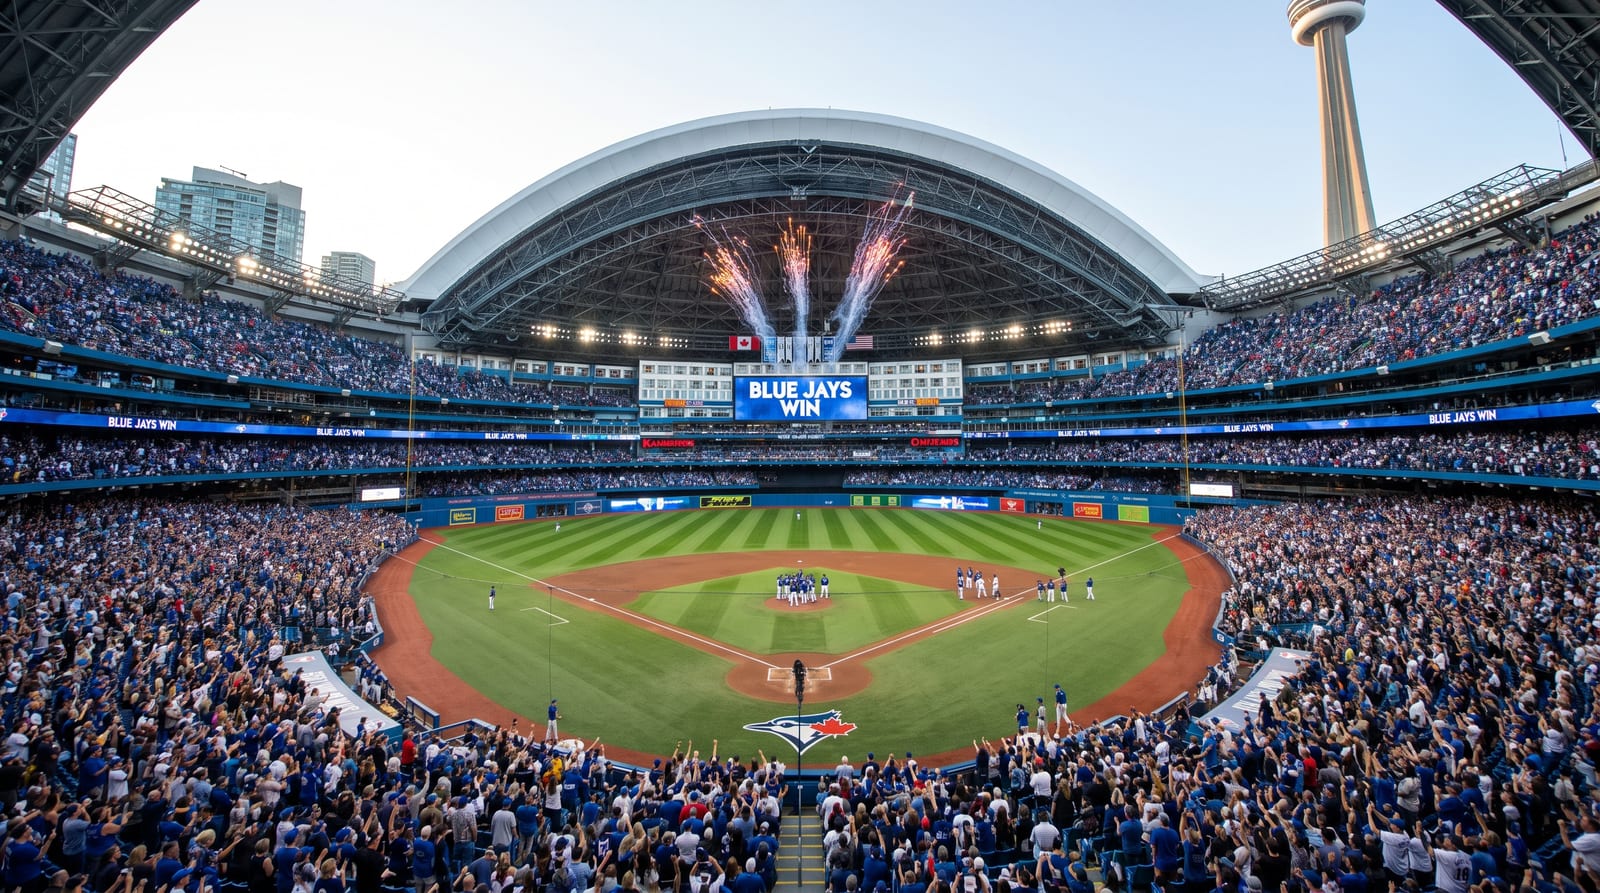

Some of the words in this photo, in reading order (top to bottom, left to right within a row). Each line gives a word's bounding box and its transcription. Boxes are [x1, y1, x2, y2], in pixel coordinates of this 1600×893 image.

[749, 381, 798, 399] BLUE
[803, 381, 853, 399] JAYS
[780, 399, 821, 417] WIN
[108, 416, 132, 428] BLUE
[134, 418, 157, 429] JAYS
[159, 420, 177, 431] WIN
[1429, 413, 1451, 424] BLUE
[1453, 412, 1476, 423] JAYS
[1477, 409, 1497, 421] WIN
[334, 428, 350, 436] JAYS
[1224, 425, 1240, 433] BLUE
[1241, 424, 1258, 432] JAYS
